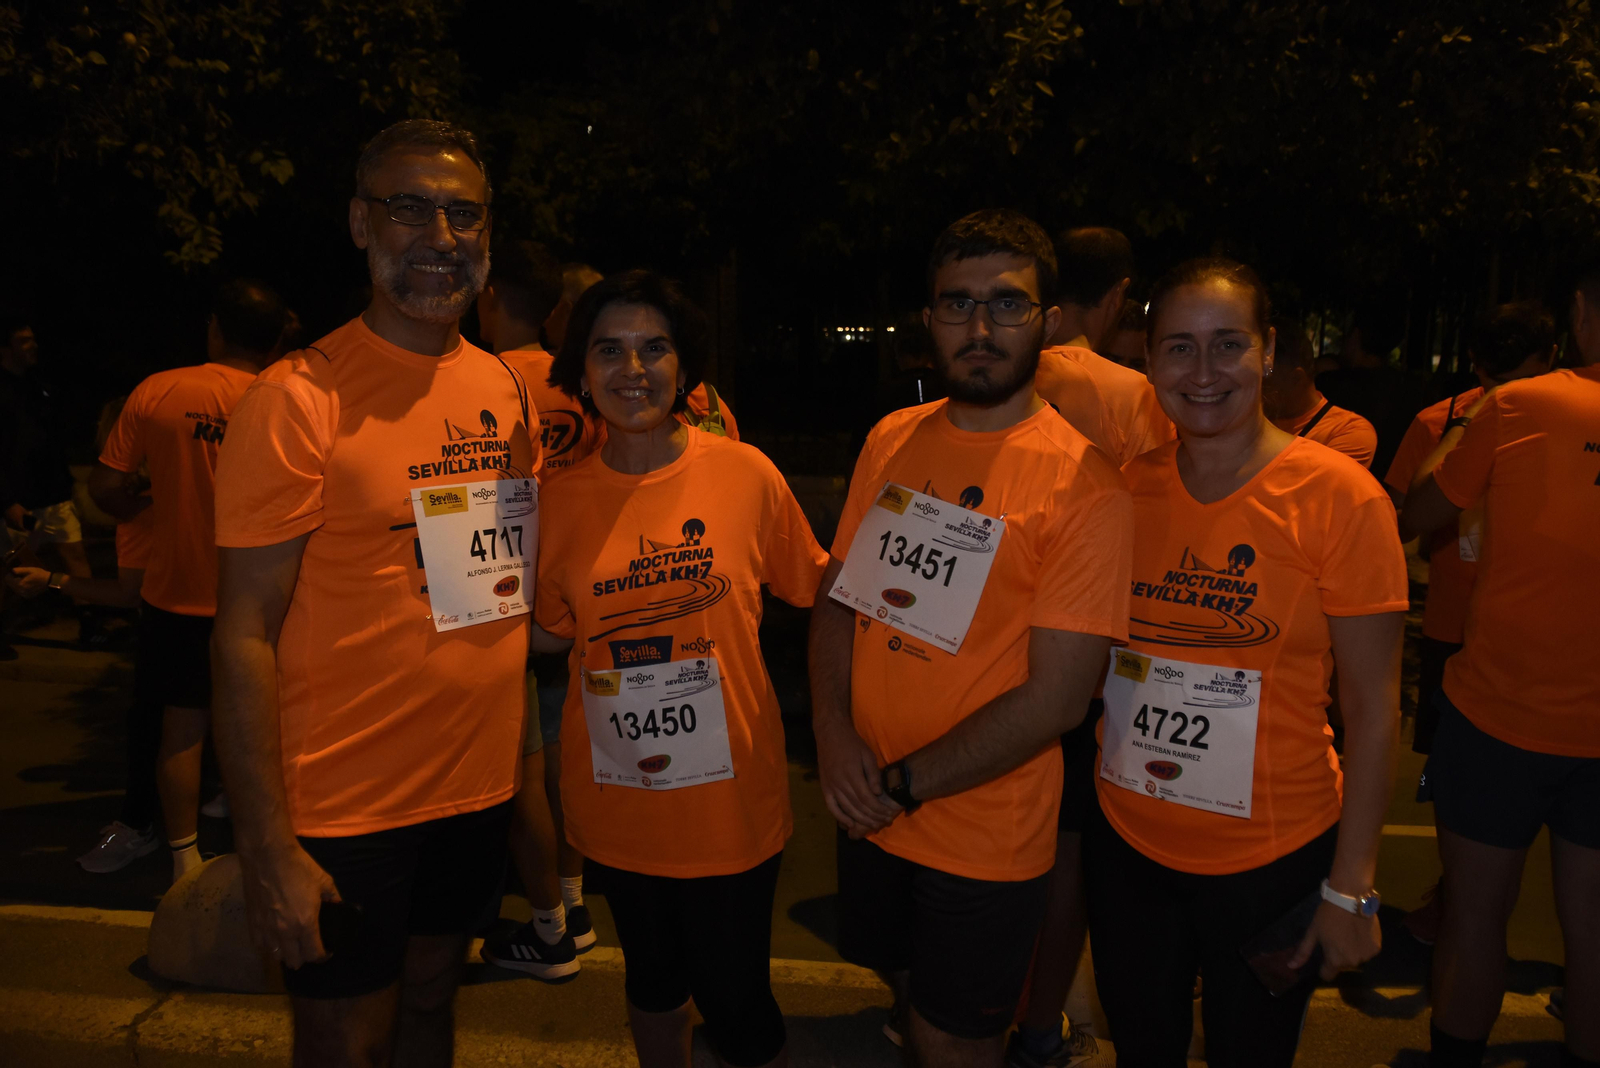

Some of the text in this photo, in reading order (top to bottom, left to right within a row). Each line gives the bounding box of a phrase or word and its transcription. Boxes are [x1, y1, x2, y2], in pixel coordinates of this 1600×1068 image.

[185, 411, 228, 426] NOCTURN
[442, 440, 511, 457] NOCTURNA
[408, 458, 479, 480] SEVILLA
[944, 523, 972, 538] SEVILLA
[959, 522, 991, 538] NOCTURNA
[470, 525, 523, 562] 4717
[628, 547, 714, 572] NOCTURNA
[879, 530, 958, 587] 13451
[467, 568, 493, 578] ALFONSO
[498, 563, 513, 572] LERMA
[592, 570, 668, 597] SEVILLA
[1162, 570, 1258, 597] NOCTURNA
[665, 676, 692, 686] SEVILLA
[677, 669, 709, 678] NOCTURNA
[1193, 684, 1226, 694] SEVILLA
[1210, 679, 1248, 689] NOCTURNA
[609, 704, 697, 741] 13450
[1133, 703, 1210, 750] 4722
[1132, 740, 1144, 749] ANA
[1144, 744, 1172, 756] ESTEBAN
